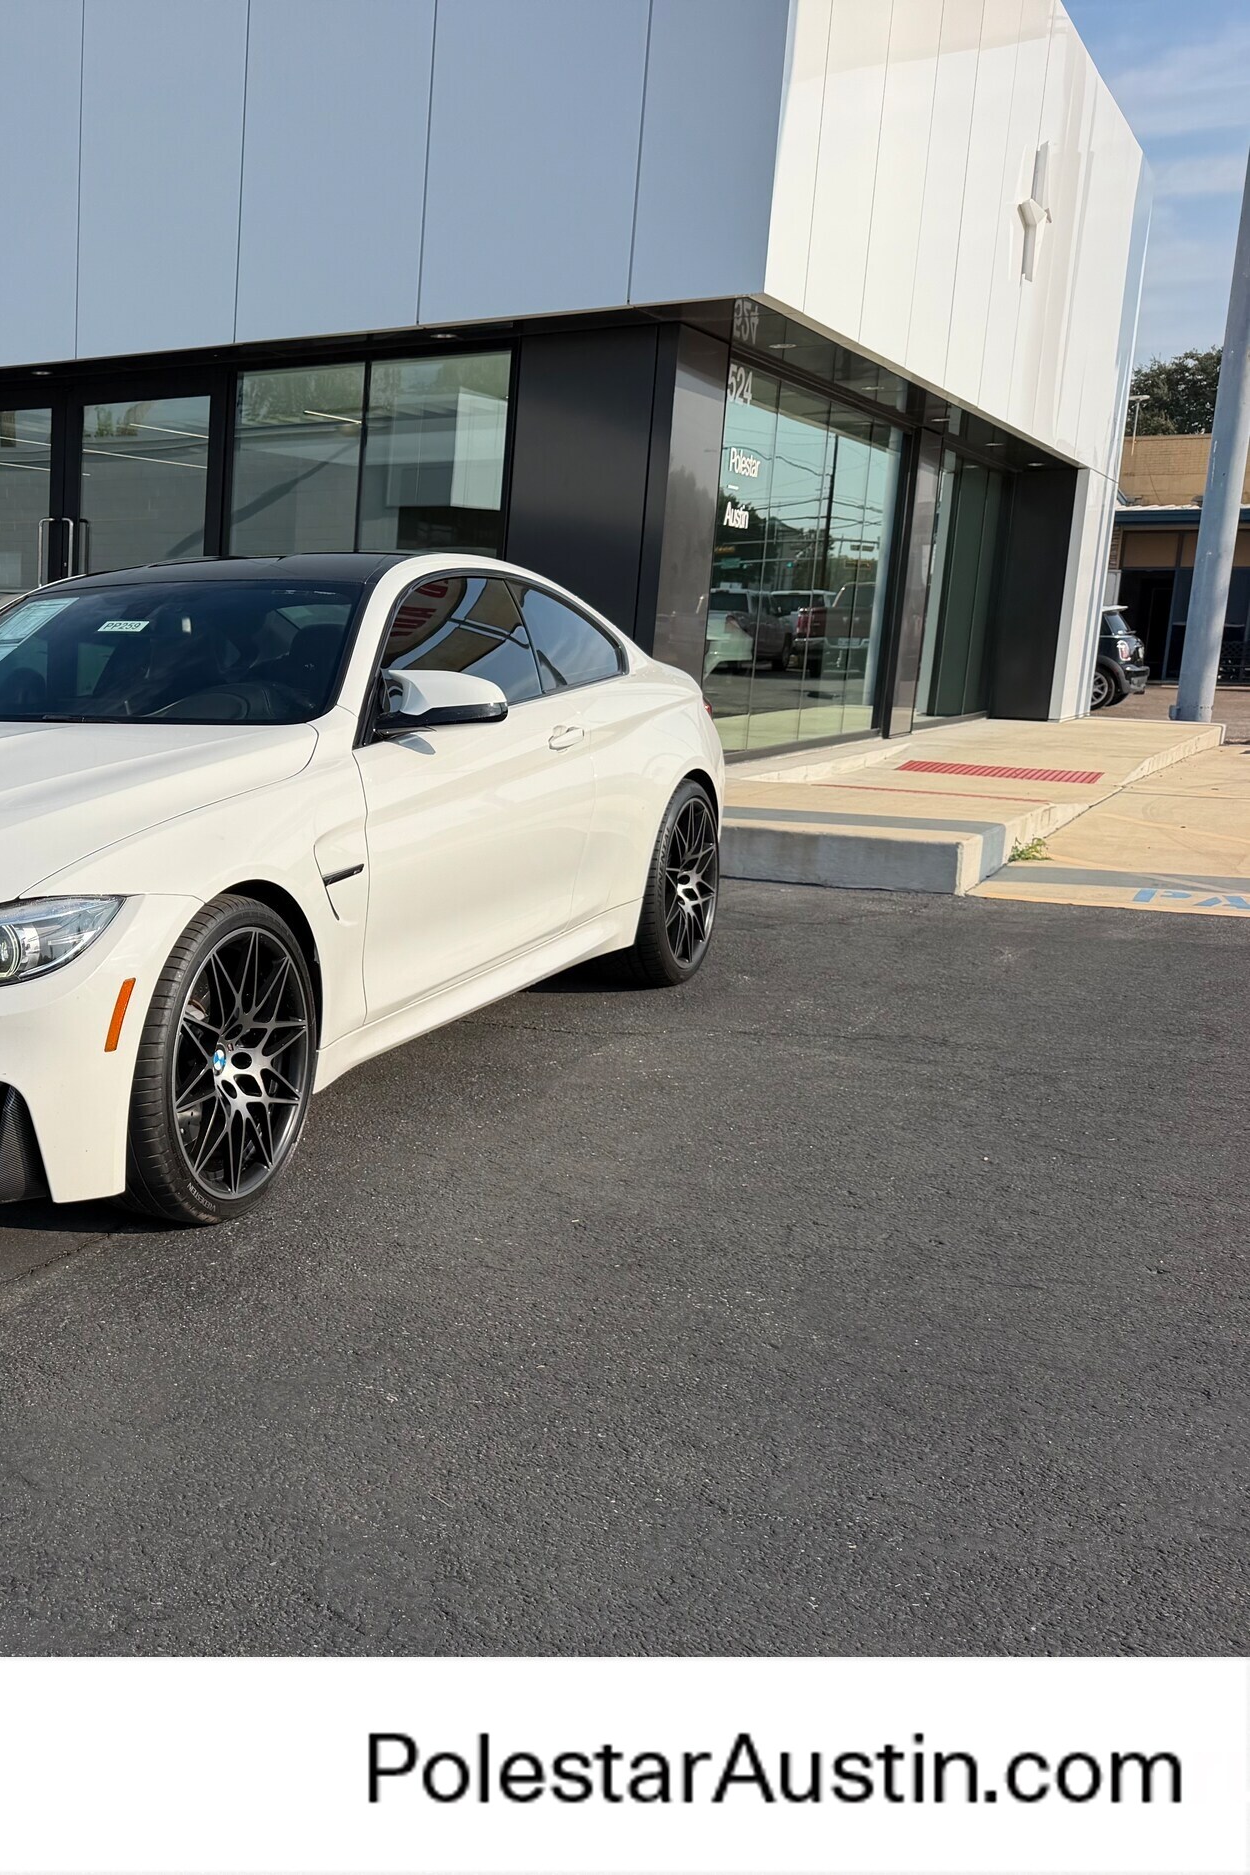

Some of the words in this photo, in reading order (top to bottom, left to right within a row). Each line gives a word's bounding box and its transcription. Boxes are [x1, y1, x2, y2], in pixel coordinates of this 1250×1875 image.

[727, 363, 753, 406] 524
[729, 446, 761, 478] Polestar
[723, 500, 750, 530] Austin
[103, 622, 142, 630] PP259
